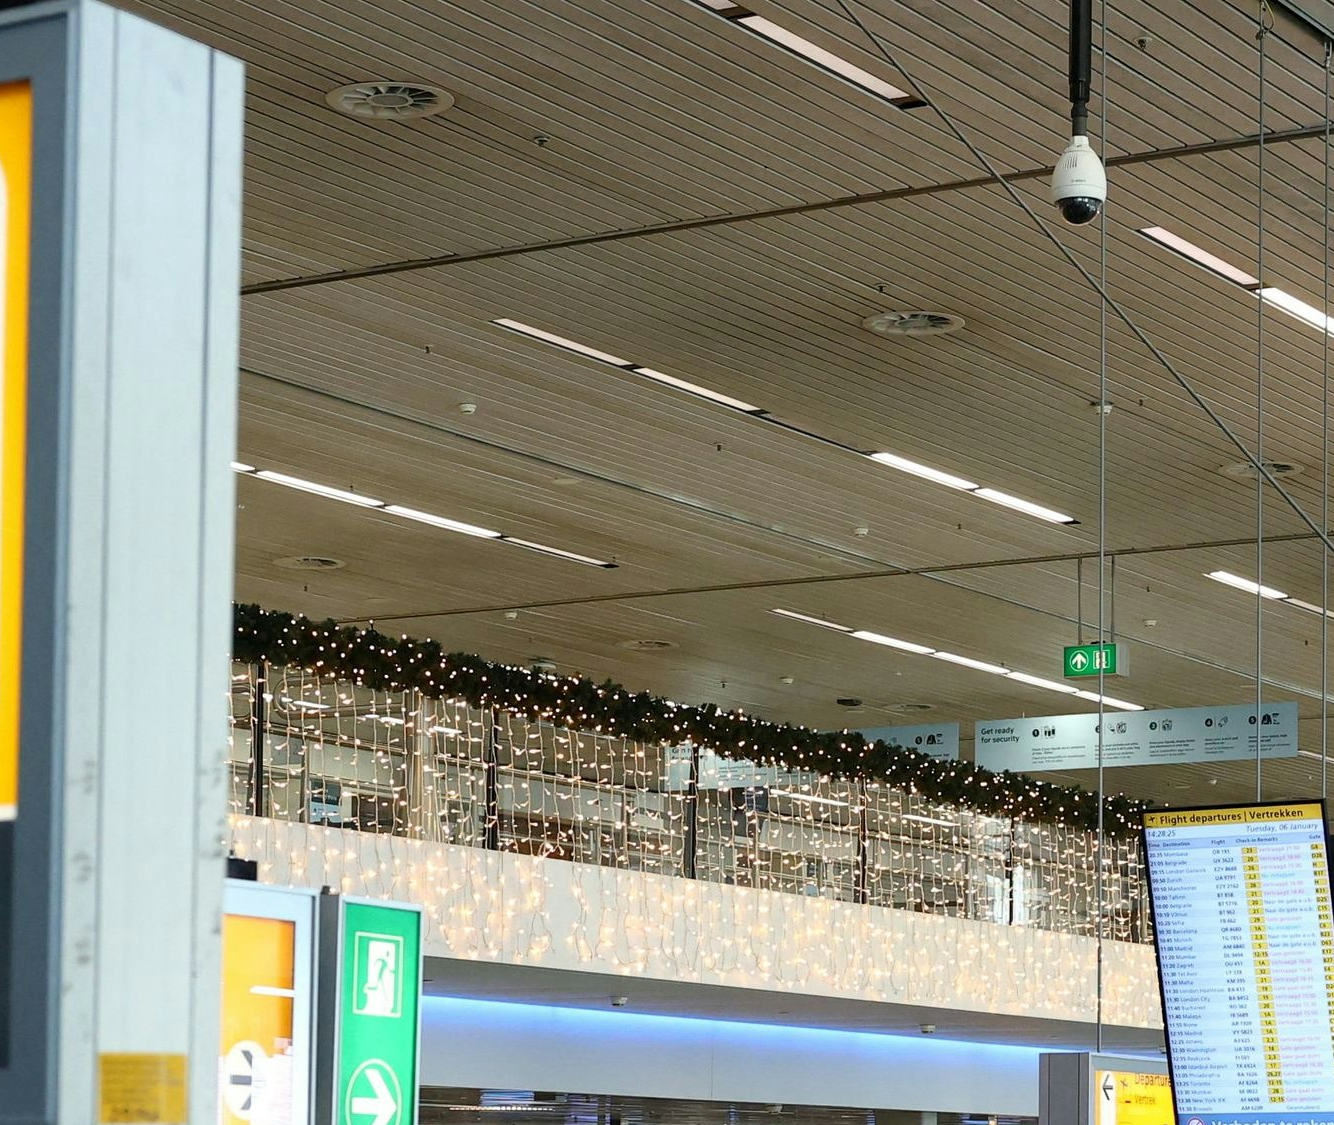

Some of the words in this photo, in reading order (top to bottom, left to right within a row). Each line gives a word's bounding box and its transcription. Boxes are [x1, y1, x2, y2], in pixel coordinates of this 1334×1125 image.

[993, 735, 1019, 743] security
[1160, 812, 1187, 826] Flight
[1190, 810, 1241, 823] departures
[1249, 807, 1303, 818] Vertrekken
[1135, 1072, 1171, 1088] Departure
